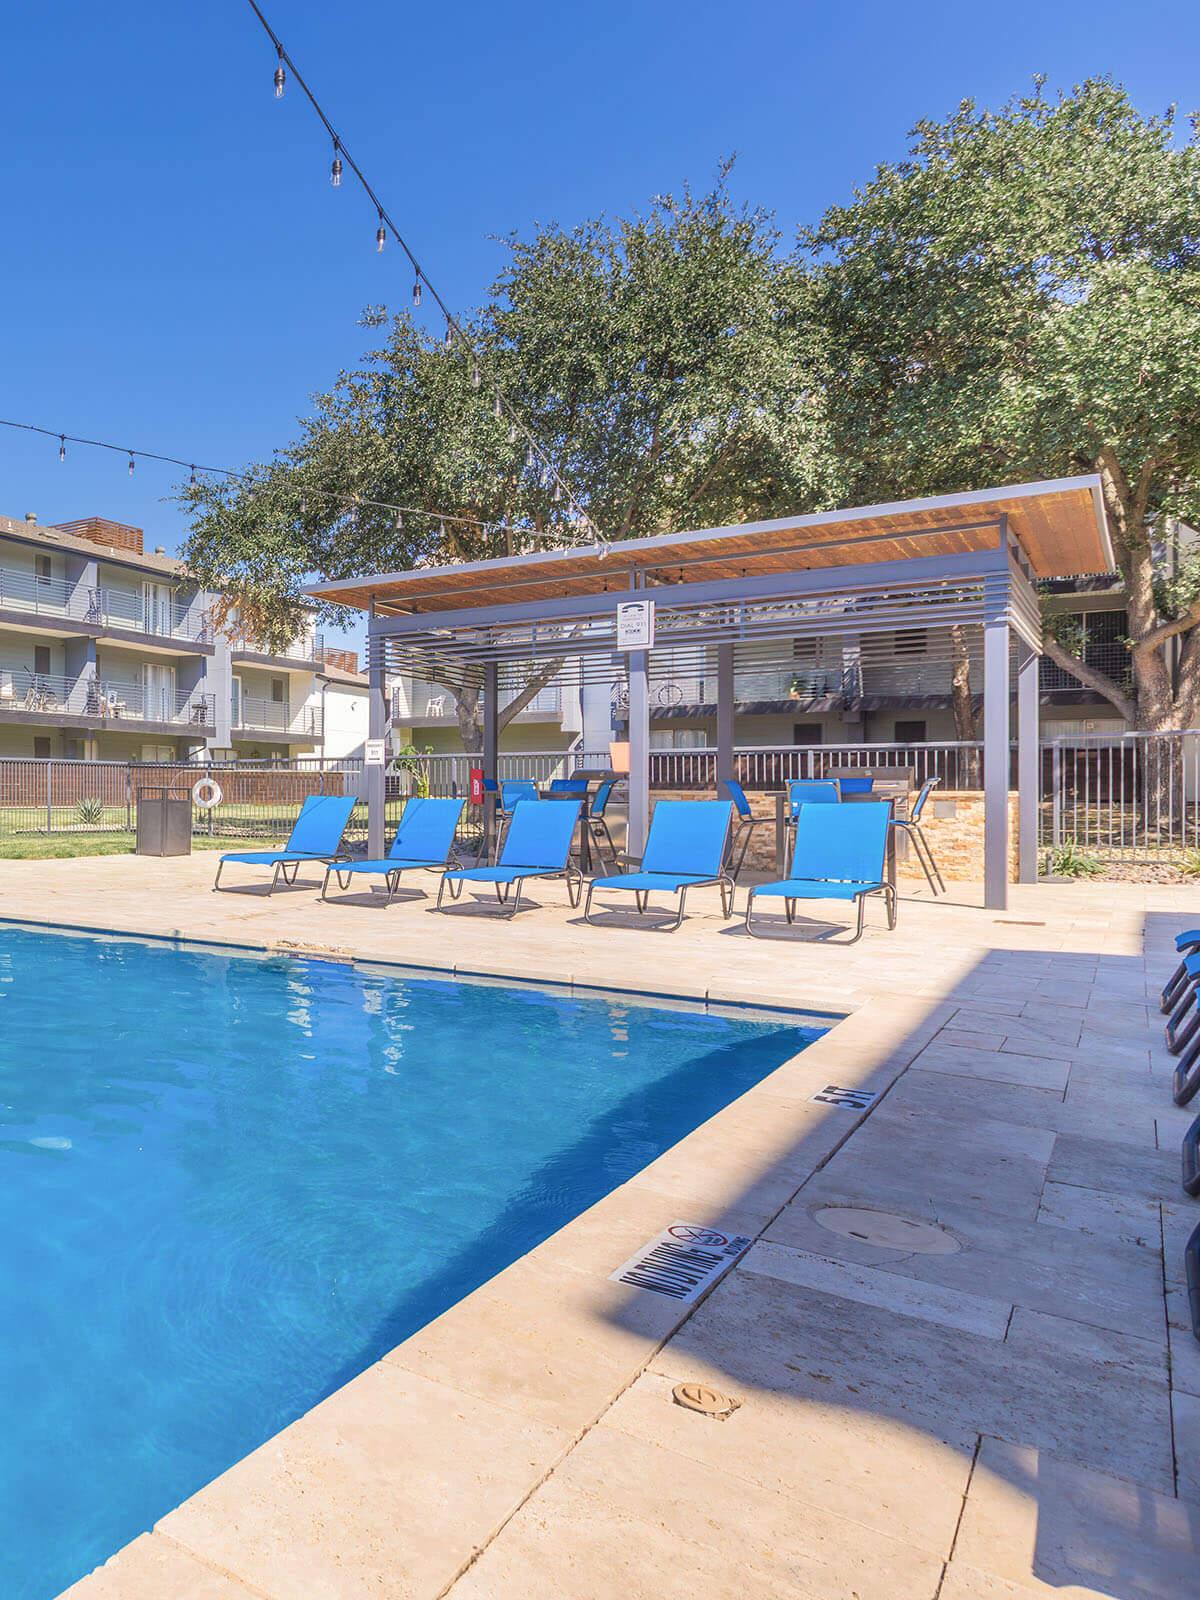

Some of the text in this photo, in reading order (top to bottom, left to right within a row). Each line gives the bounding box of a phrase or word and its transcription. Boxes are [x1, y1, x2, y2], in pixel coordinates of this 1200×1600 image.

[814, 1086, 875, 1108] 5 FT
[618, 1242, 724, 1300] NO DIVING
